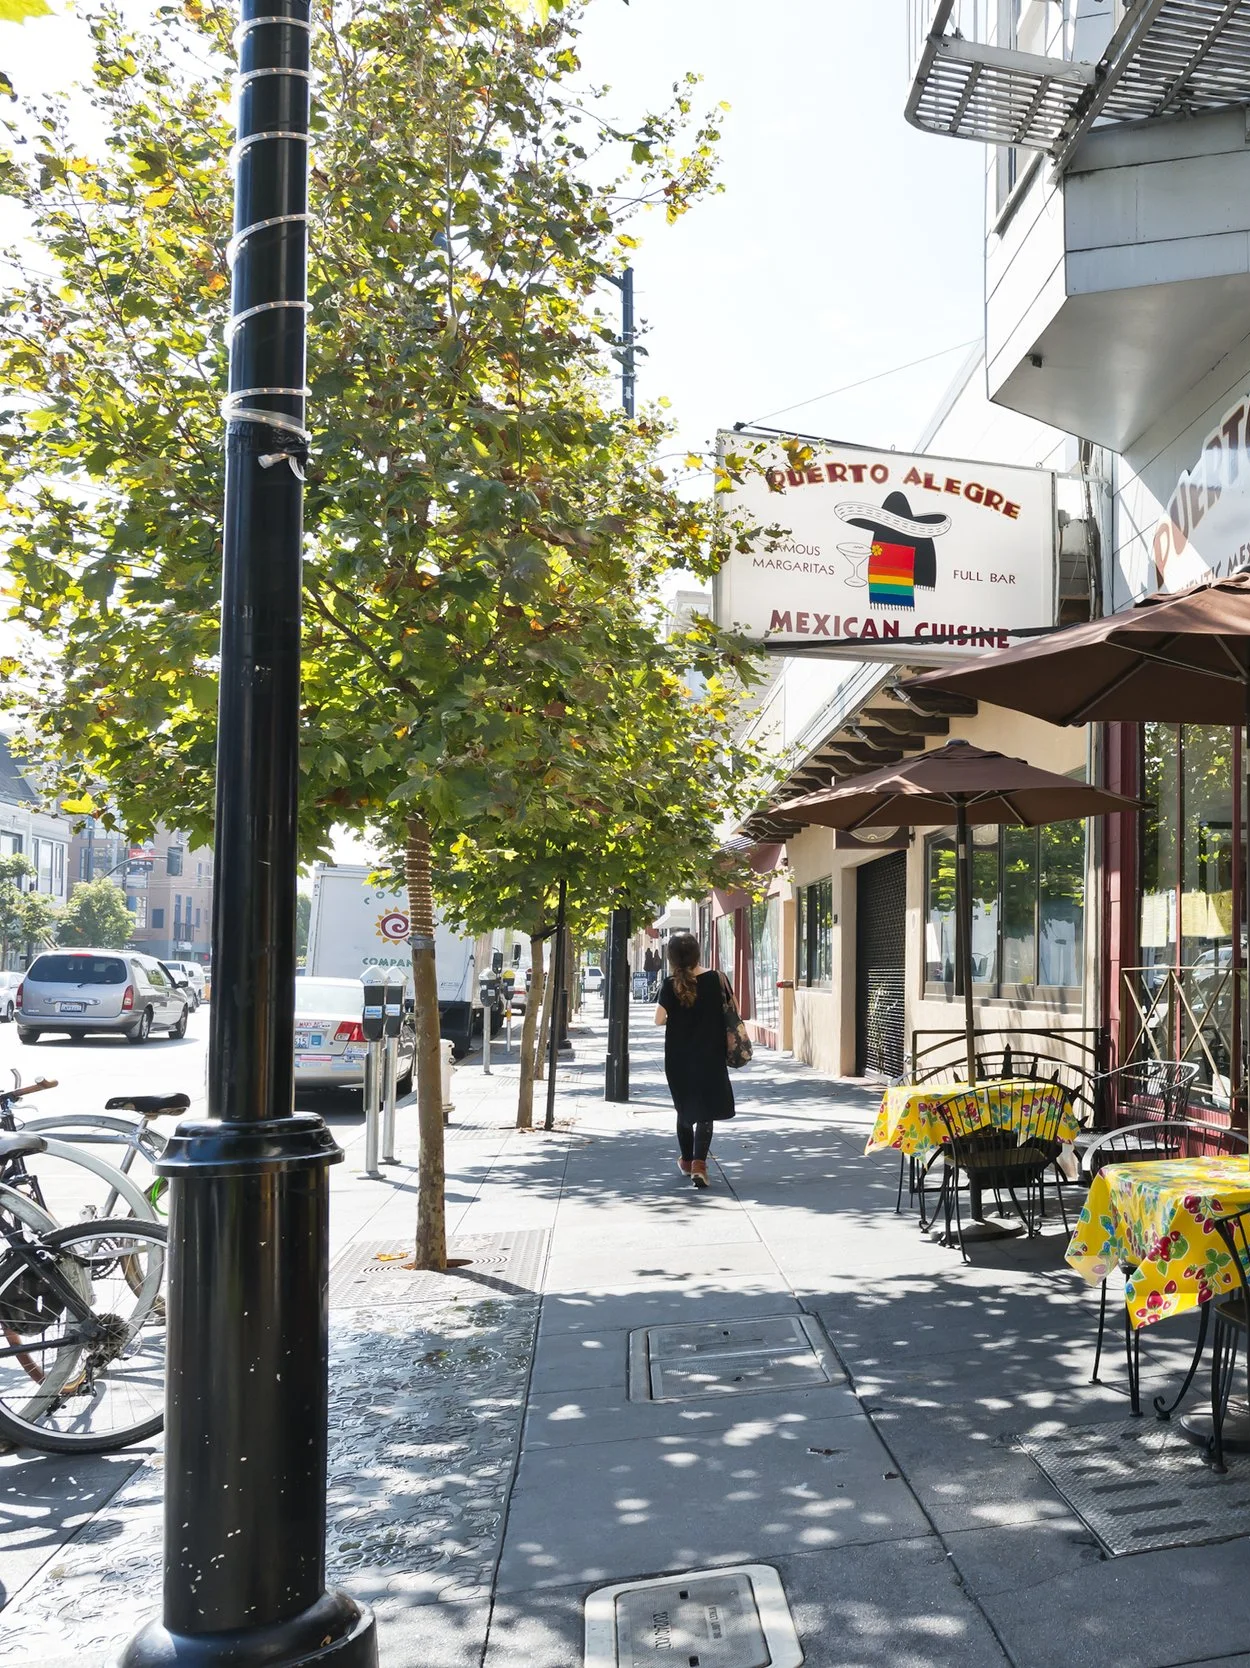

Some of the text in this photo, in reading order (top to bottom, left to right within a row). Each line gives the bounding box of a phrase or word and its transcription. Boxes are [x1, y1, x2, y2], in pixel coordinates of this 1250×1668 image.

[903, 466, 1022, 520] ALEGRE
[768, 540, 821, 556] AMOUS
[752, 558, 835, 575] MARGARITAS
[952, 569, 1017, 585] FULL BAR
[769, 609, 1010, 648] MEXICAN CUISINE
[362, 957, 413, 967] COMPAN
